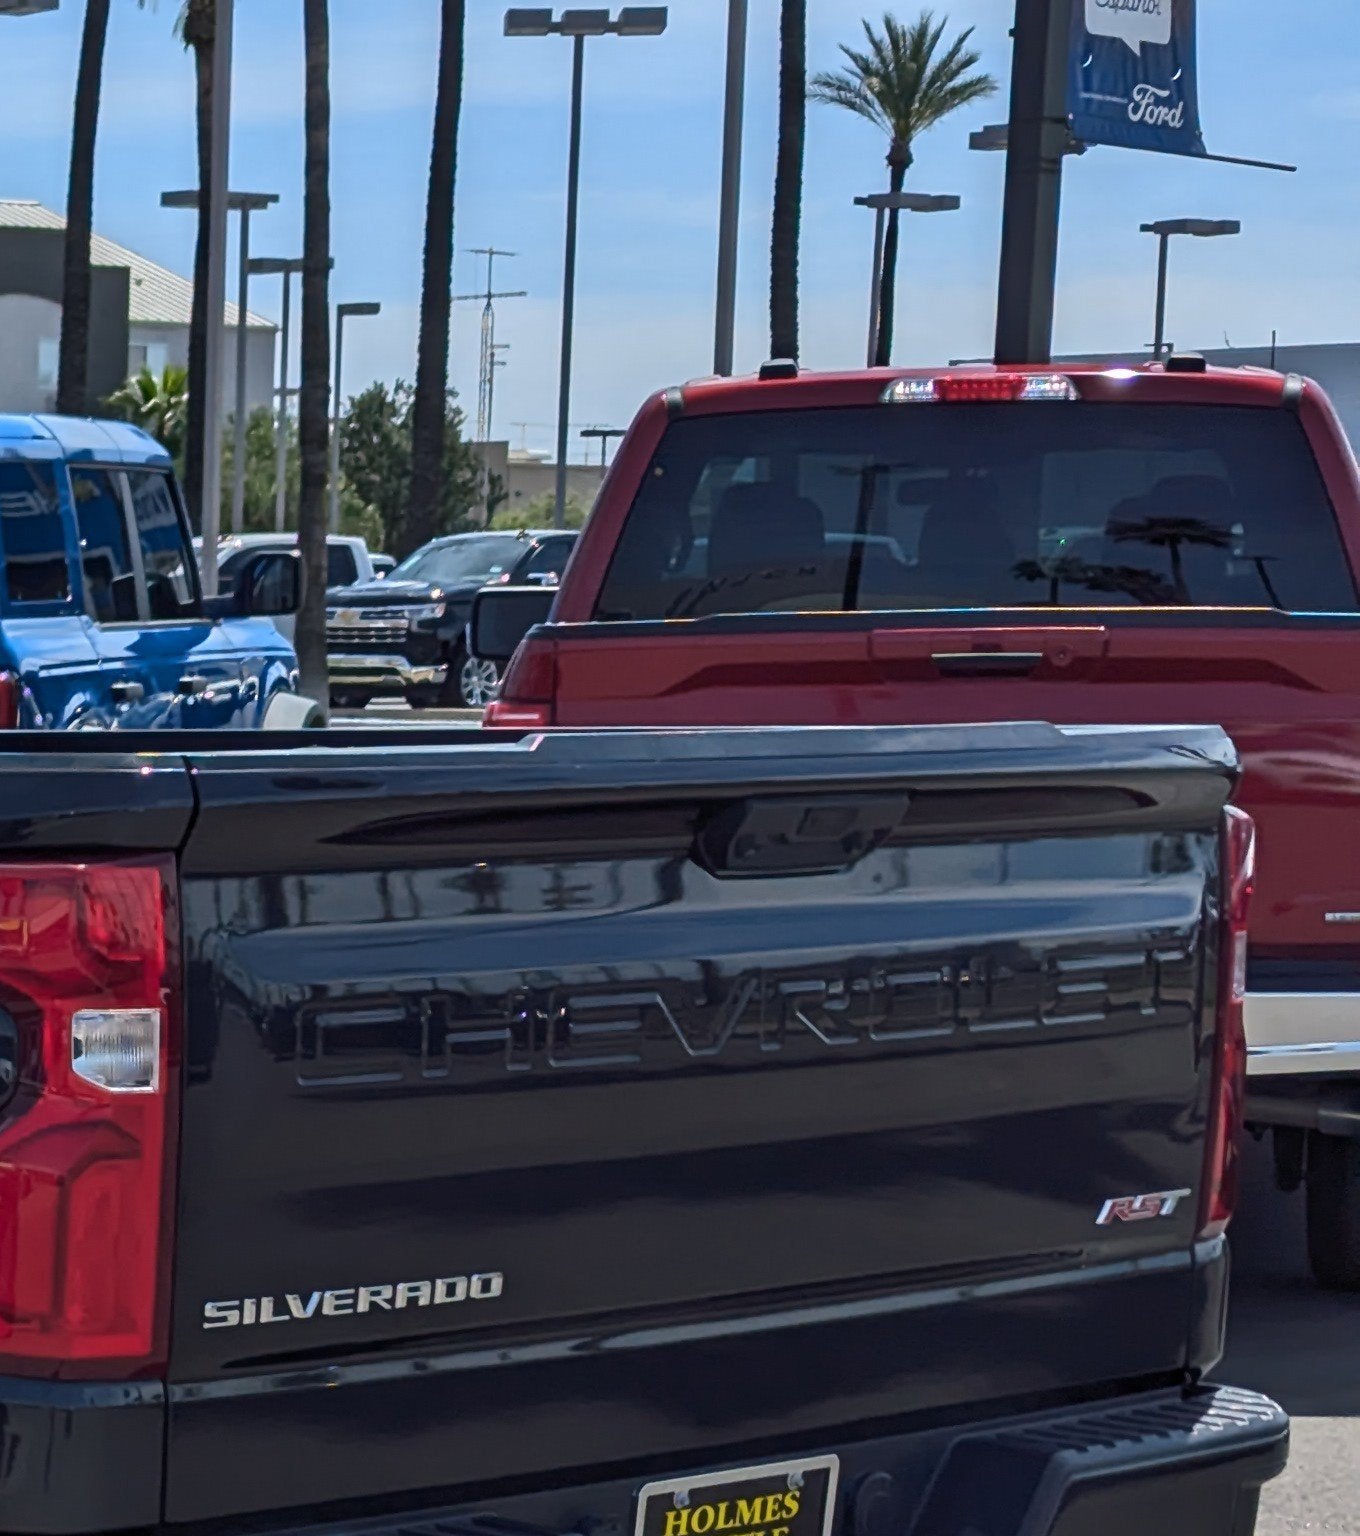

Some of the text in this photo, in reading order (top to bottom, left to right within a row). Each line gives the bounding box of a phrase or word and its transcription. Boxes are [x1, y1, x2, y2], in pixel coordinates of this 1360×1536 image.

[1127, 84, 1184, 129] Ford
[296, 949, 1188, 1086] CHEVROLET
[1095, 1187, 1192, 1226] RST
[202, 1271, 504, 1329] SILVERADO
